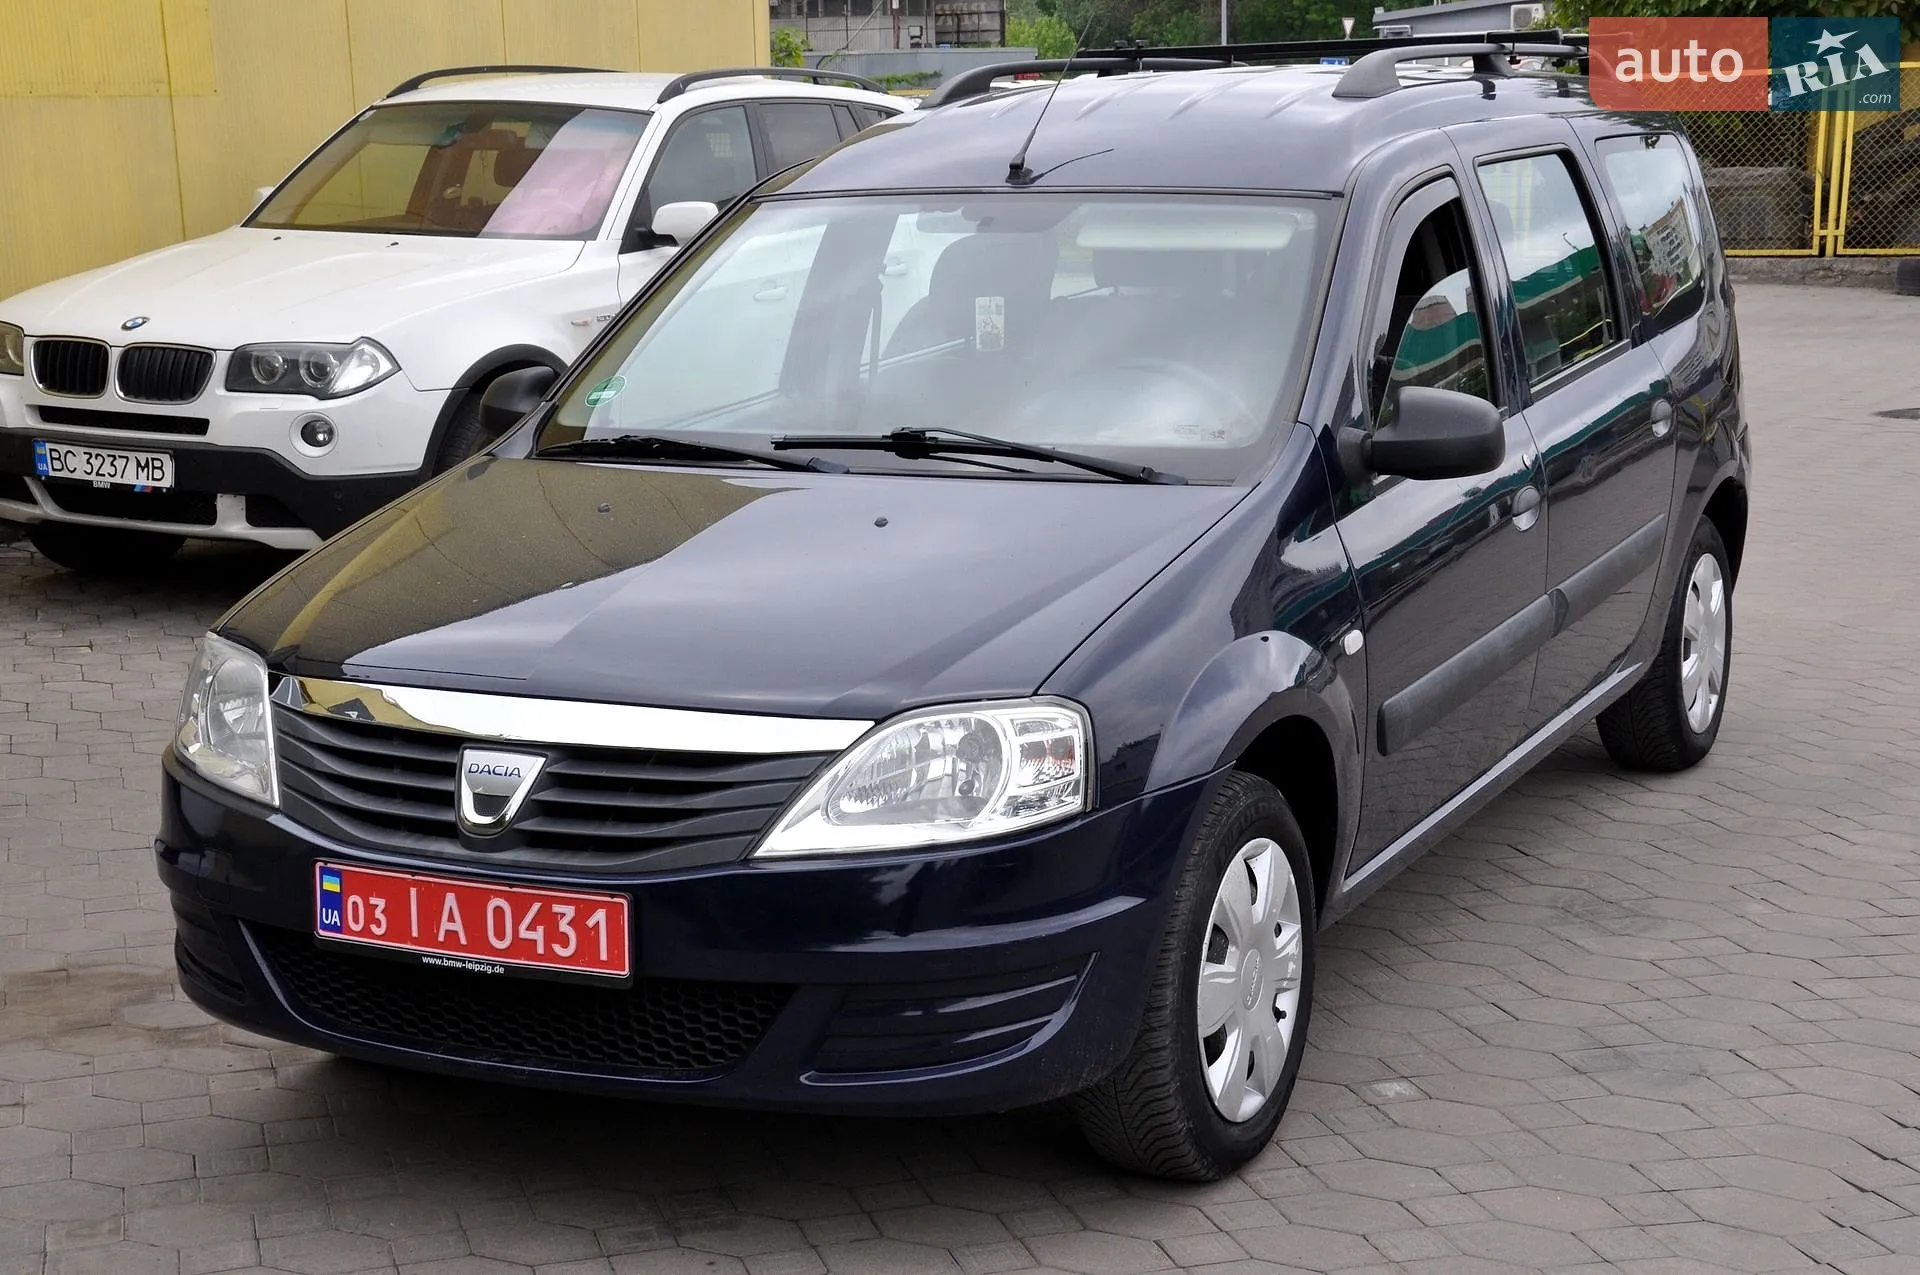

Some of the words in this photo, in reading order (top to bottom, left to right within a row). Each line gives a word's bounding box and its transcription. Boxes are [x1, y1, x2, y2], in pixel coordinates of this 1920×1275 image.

[37, 463, 48, 471] UA
[49, 448, 77, 474] BC
[83, 451, 130, 479] 3237
[134, 455, 165, 482] MB
[92, 480, 111, 489] BMW
[468, 762, 521, 778] DACIA
[321, 908, 341, 926] UA
[347, 894, 388, 936] 03
[486, 897, 609, 961] 0431
[421, 955, 505, 974] www.bmw-leipzig.de
